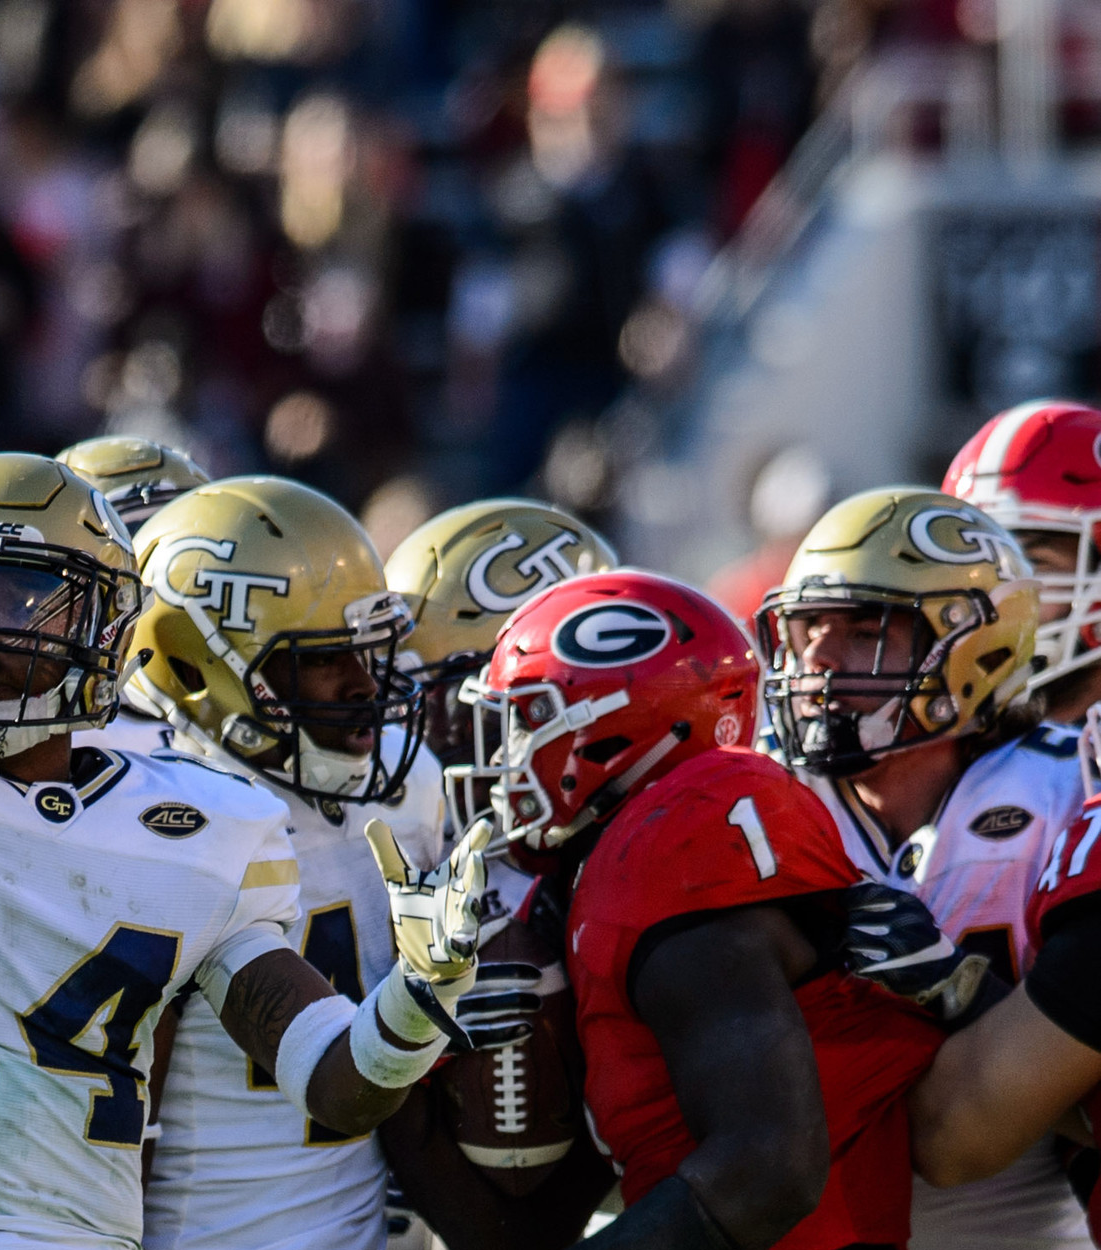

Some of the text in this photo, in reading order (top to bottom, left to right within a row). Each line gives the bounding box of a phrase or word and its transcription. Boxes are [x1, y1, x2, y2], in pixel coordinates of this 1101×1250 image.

[908, 508, 1017, 582] GT
[152, 536, 290, 633] GT
[557, 604, 667, 664] G
[40, 795, 72, 816] GT
[150, 810, 199, 825] ACC
[978, 811, 1024, 830] ACC
[726, 795, 778, 881] 1
